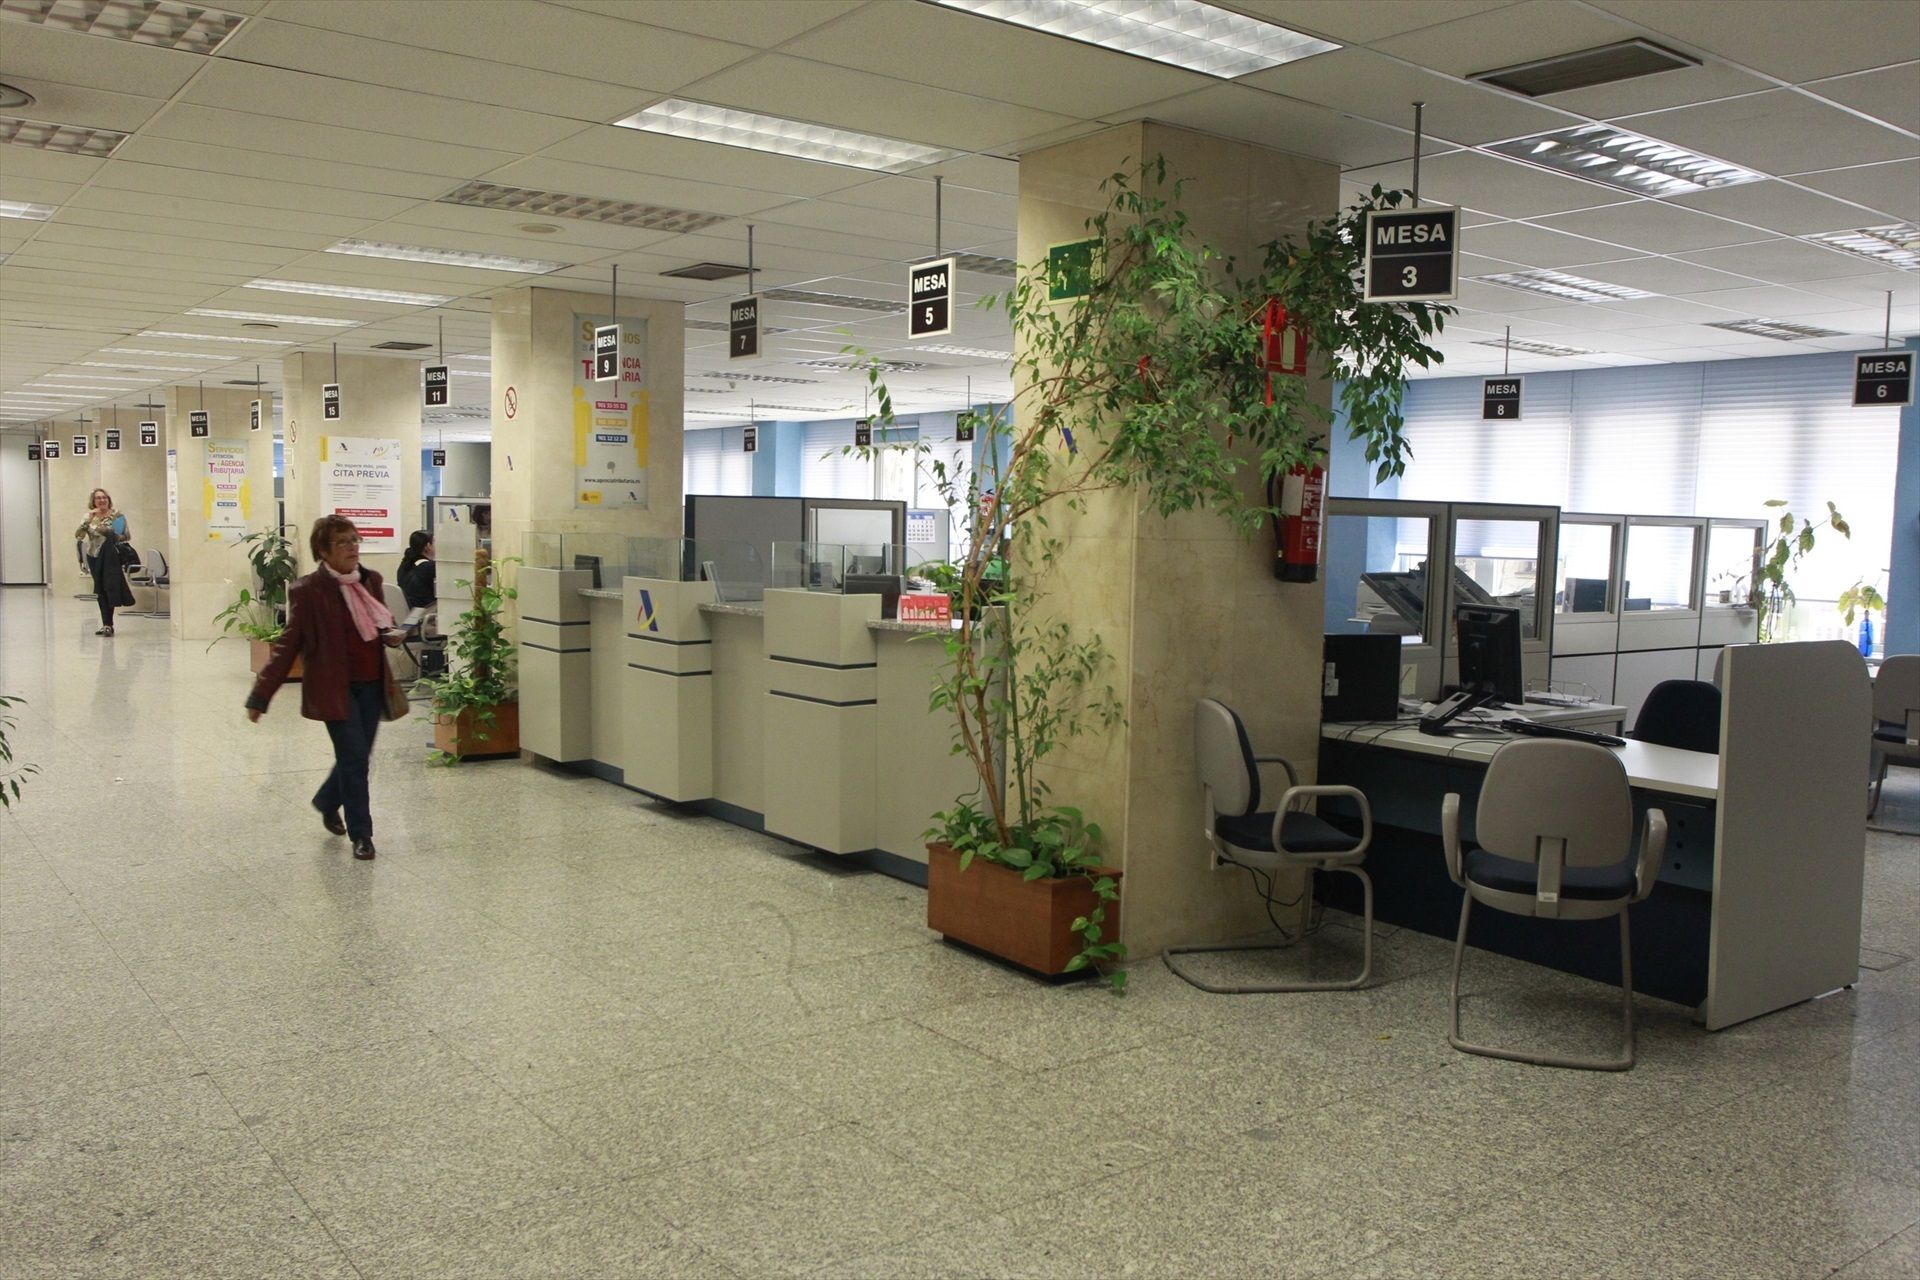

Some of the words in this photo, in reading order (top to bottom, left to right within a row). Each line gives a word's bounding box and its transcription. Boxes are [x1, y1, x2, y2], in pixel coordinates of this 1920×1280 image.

[1377, 223, 1446, 245] MESA
[914, 273, 946, 293] MESA
[1401, 265, 1417, 288] 3
[732, 306, 756, 322] MESA
[925, 307, 933, 325] 5
[597, 334, 616, 348] MESA
[740, 335, 747, 350] 7
[604, 359, 609, 373] 9
[1861, 361, 1906, 374] MESA
[427, 371, 446, 381] MESA
[325, 390, 338, 398] MESA
[1487, 384, 1517, 394] MESA
[1876, 384, 1888, 398] 6
[432, 391, 440, 402] 11
[328, 406, 336, 416] 15
[1497, 404, 1504, 416] 8
[961, 431, 968, 439] 12
[208, 463, 245, 474] TRIBUTARIA
[333, 469, 354, 477] CITA
[356, 470, 390, 478] PREVIA
